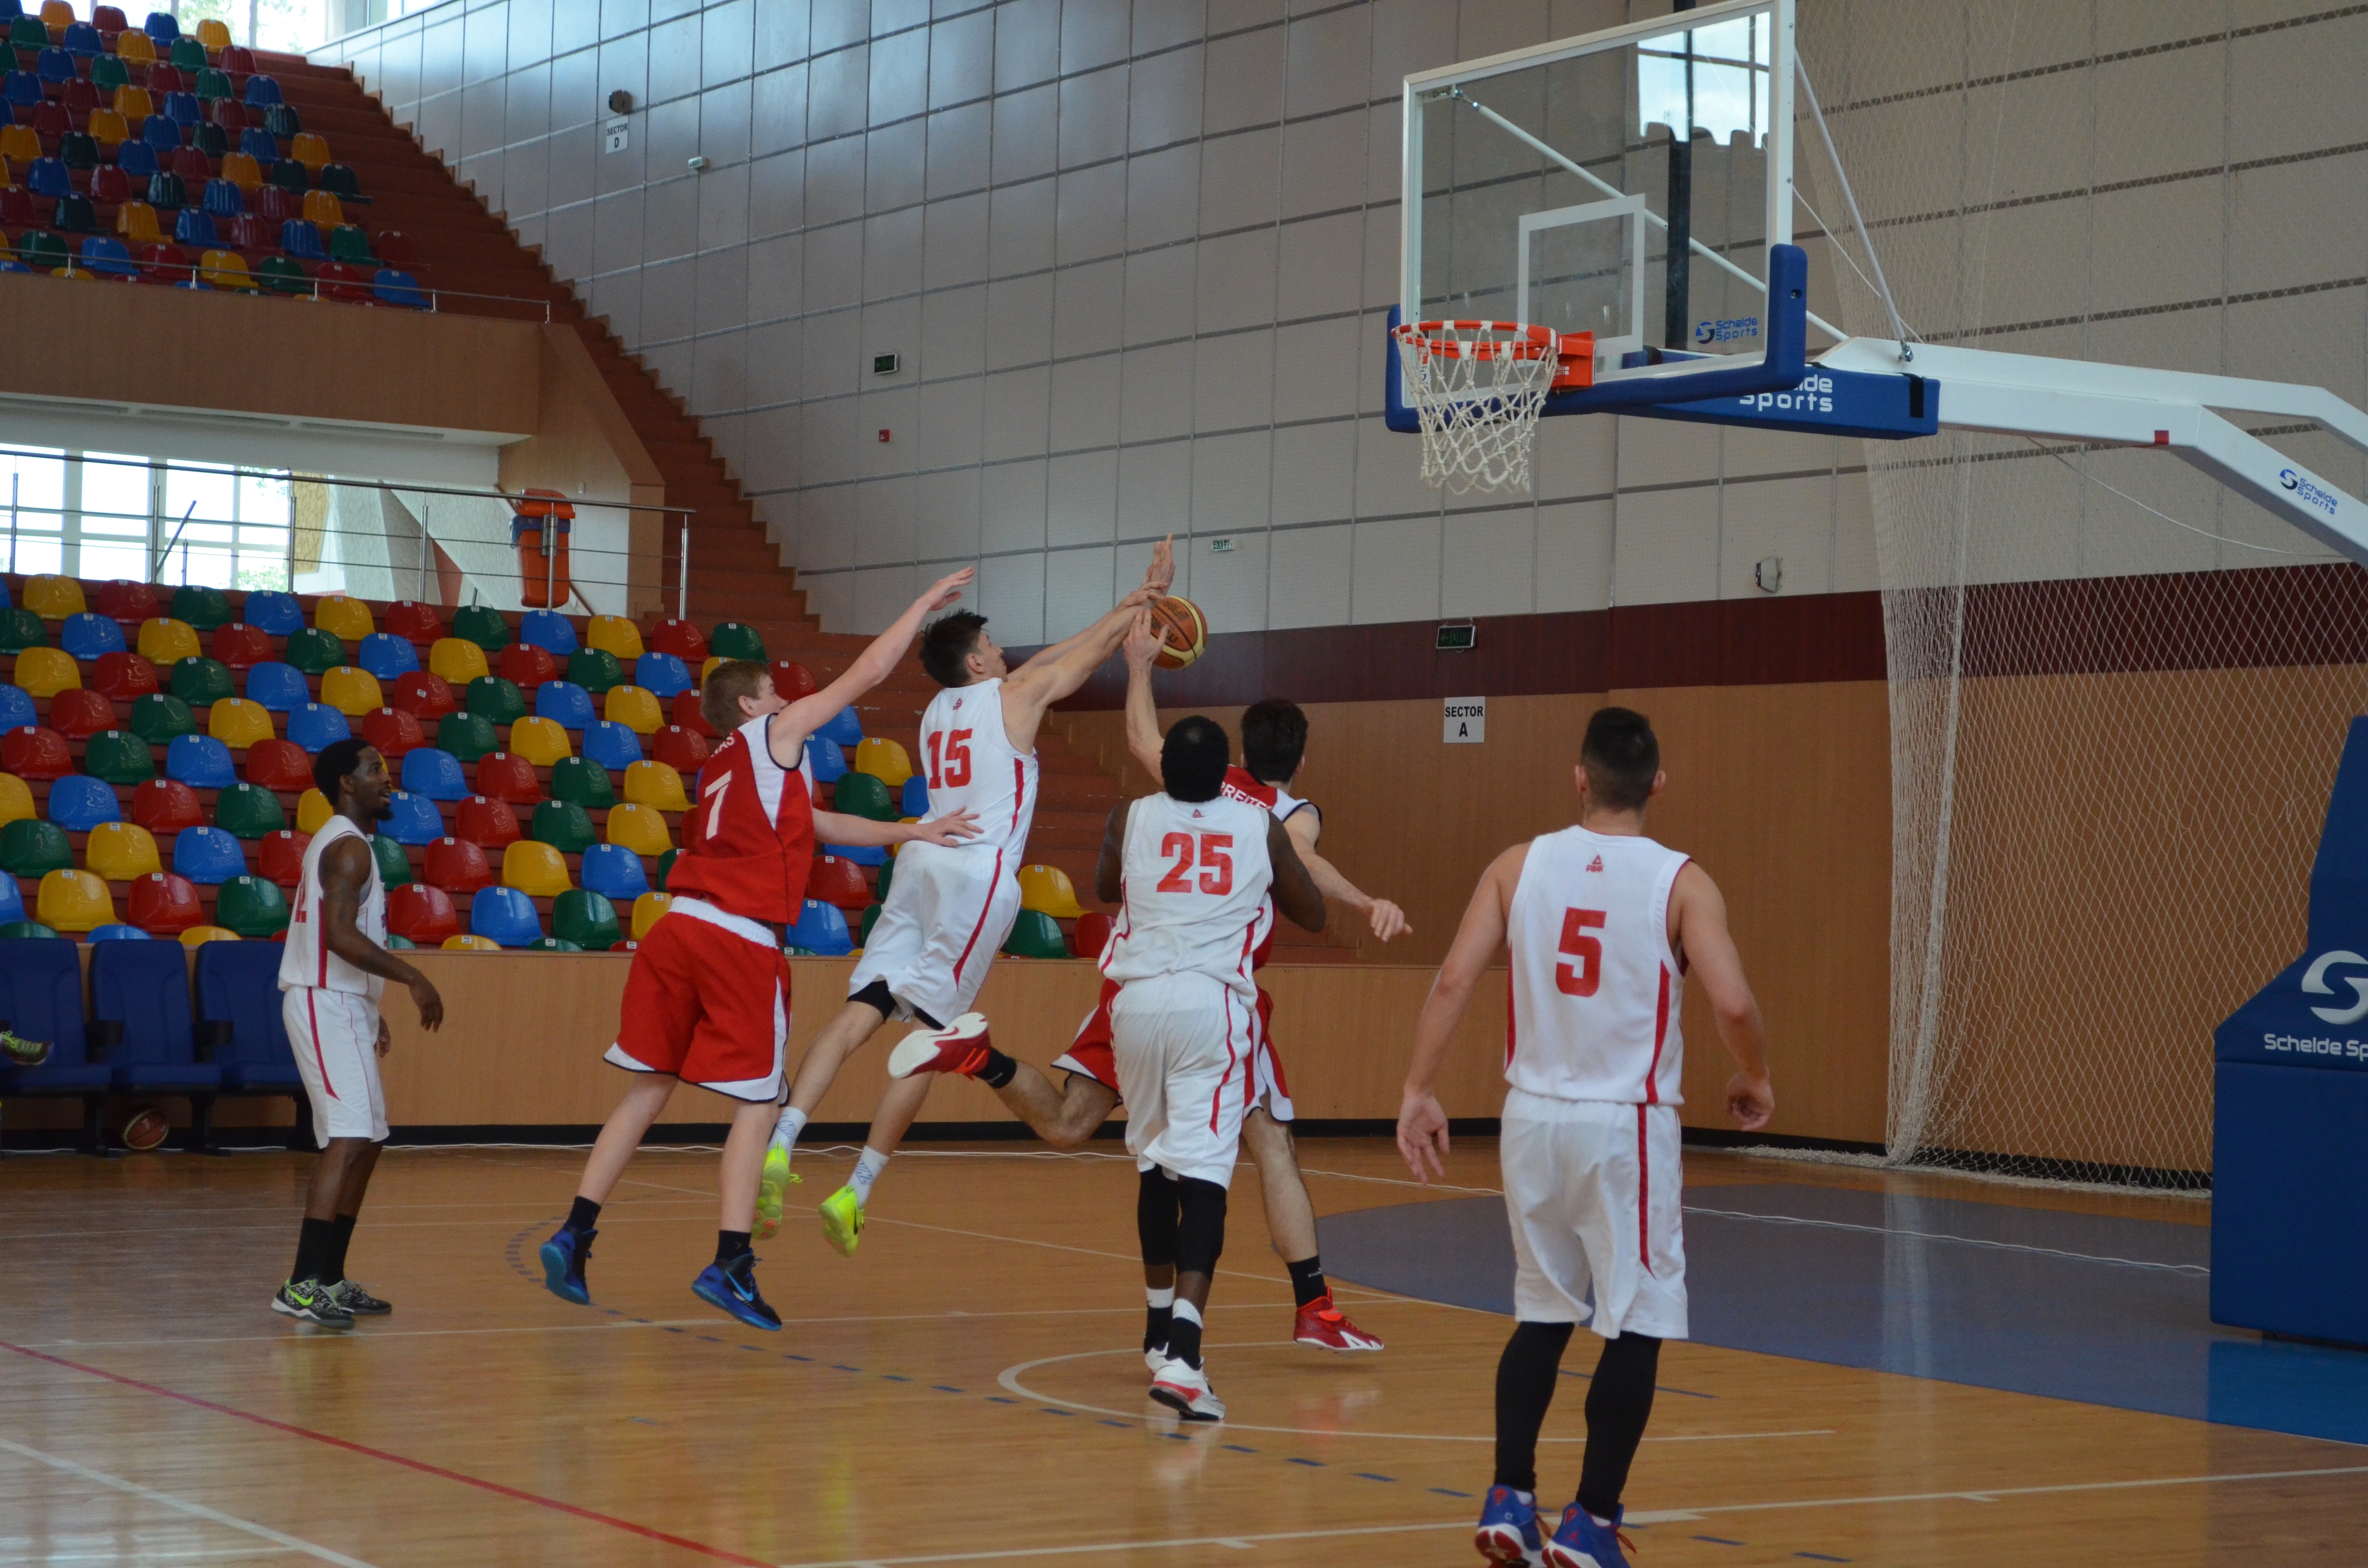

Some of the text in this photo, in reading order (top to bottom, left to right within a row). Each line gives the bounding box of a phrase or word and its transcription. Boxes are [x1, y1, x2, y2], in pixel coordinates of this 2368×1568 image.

[607, 122, 628, 135] SECTOR
[614, 137, 619, 148] D
[1716, 317, 1758, 330] Schelde
[1715, 328, 1758, 342] Sports
[2297, 486, 2336, 515] Sports
[2299, 478, 2338, 507] Schelde
[1213, 539, 1228, 550] EXIT
[1445, 706, 1483, 717] SECTOR
[1459, 722, 1468, 737] A
[927, 728, 973, 789] 15
[704, 770, 732, 840] 7
[1156, 832, 1233, 896] 25
[1555, 907, 1607, 998] 5
[2264, 1033, 2342, 1055] Schelde
